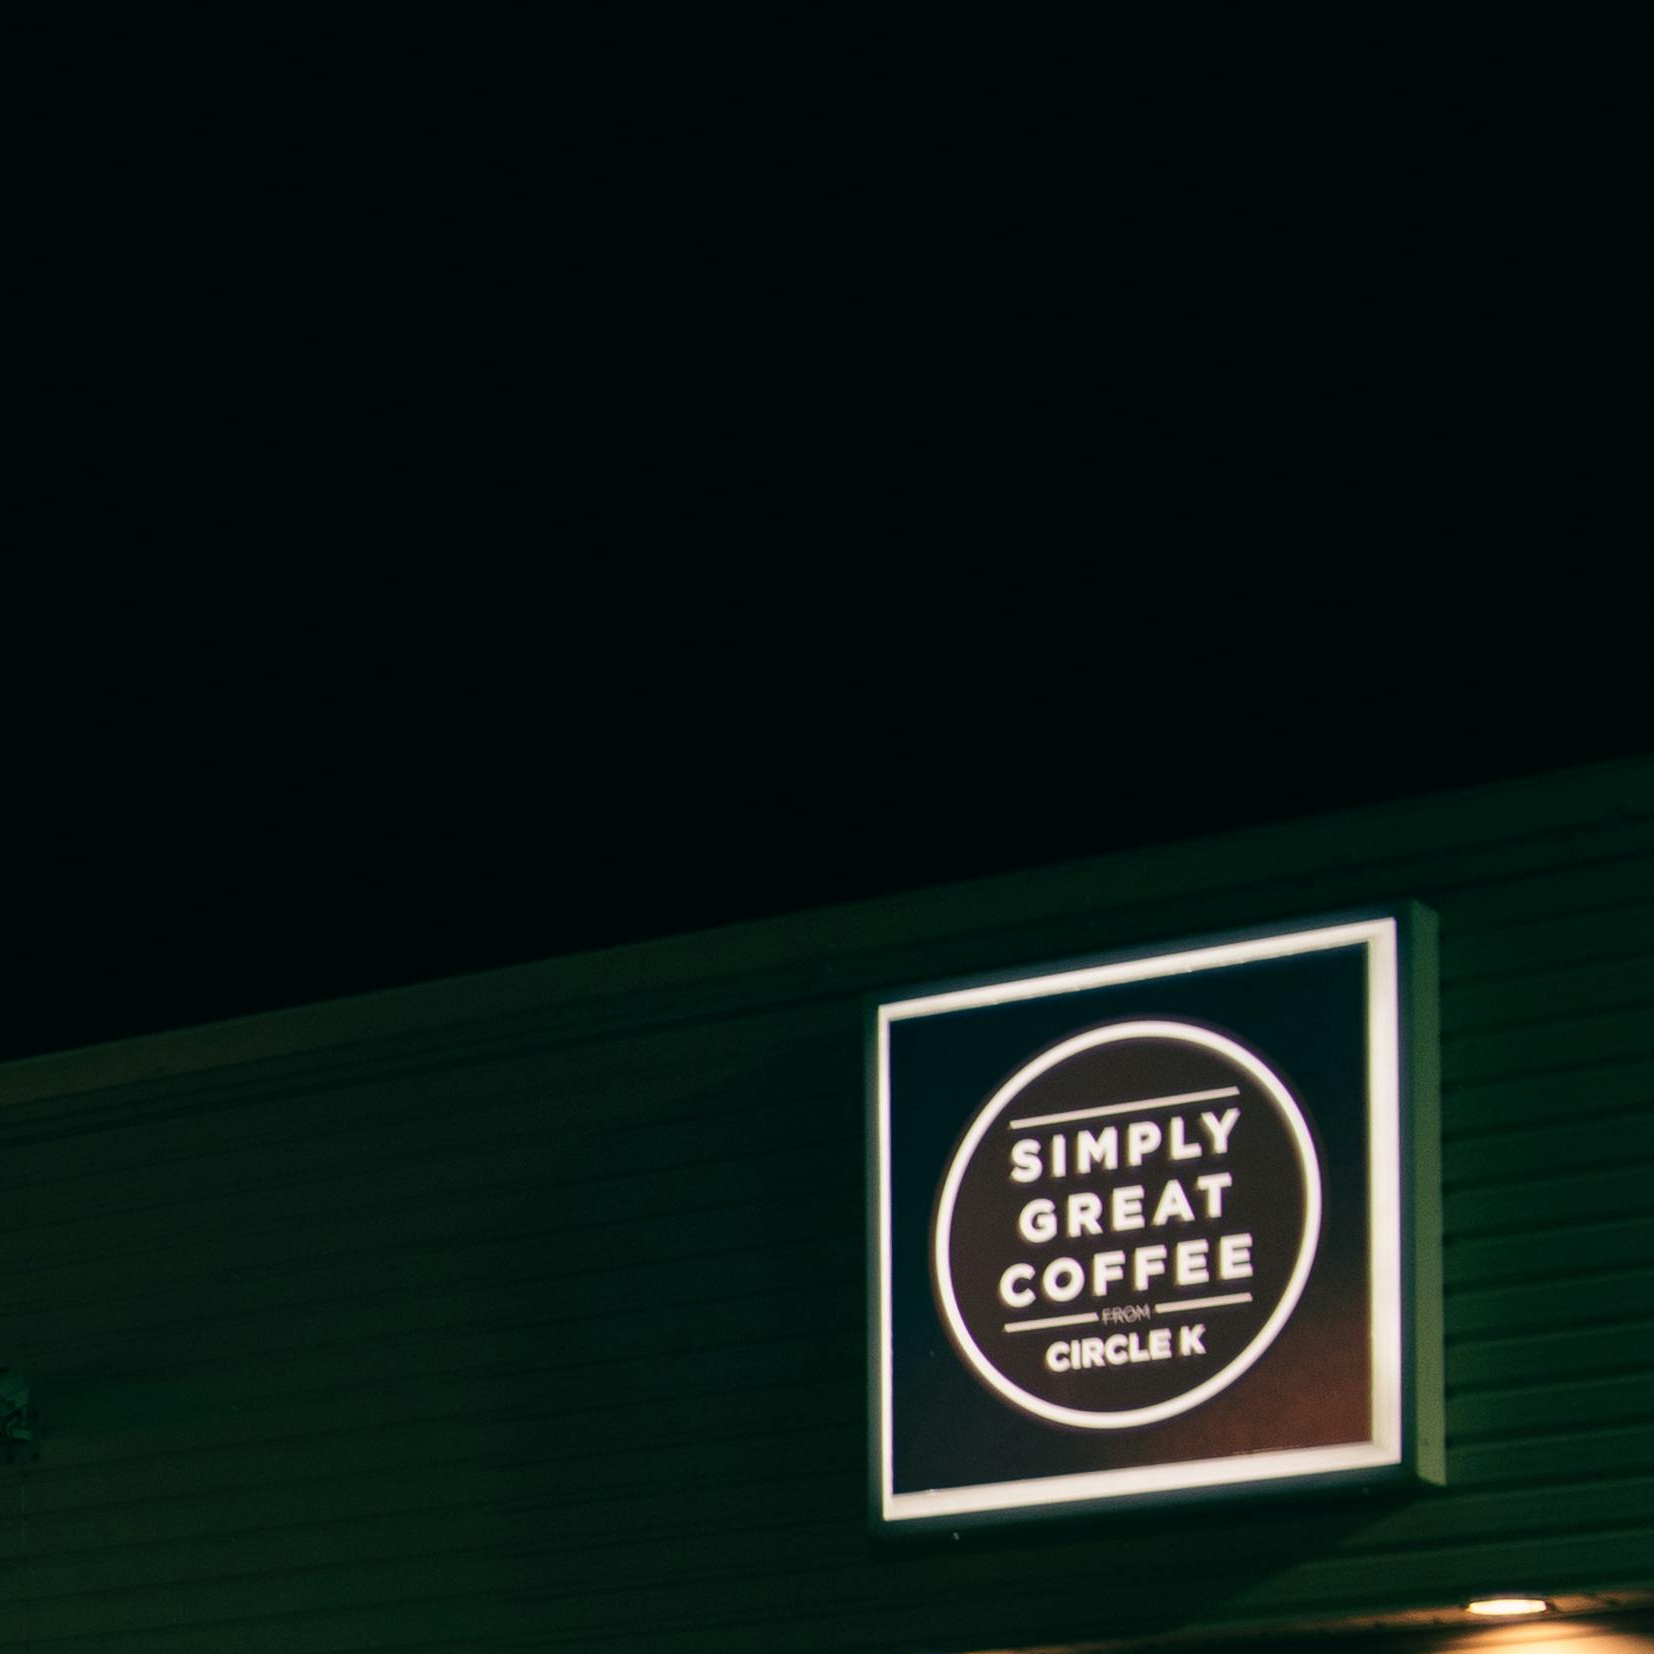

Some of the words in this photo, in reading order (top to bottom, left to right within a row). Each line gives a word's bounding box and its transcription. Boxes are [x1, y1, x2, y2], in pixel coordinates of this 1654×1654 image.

[1010, 1107, 1241, 1183] SIMPLY
[1018, 1172, 1233, 1243] GREAT
[998, 1232, 1253, 1308] COFFEE
[1045, 1327, 1173, 1373] CIRCLE
[1179, 1323, 1207, 1357] K
[1101, 1303, 1152, 1326] FROM
